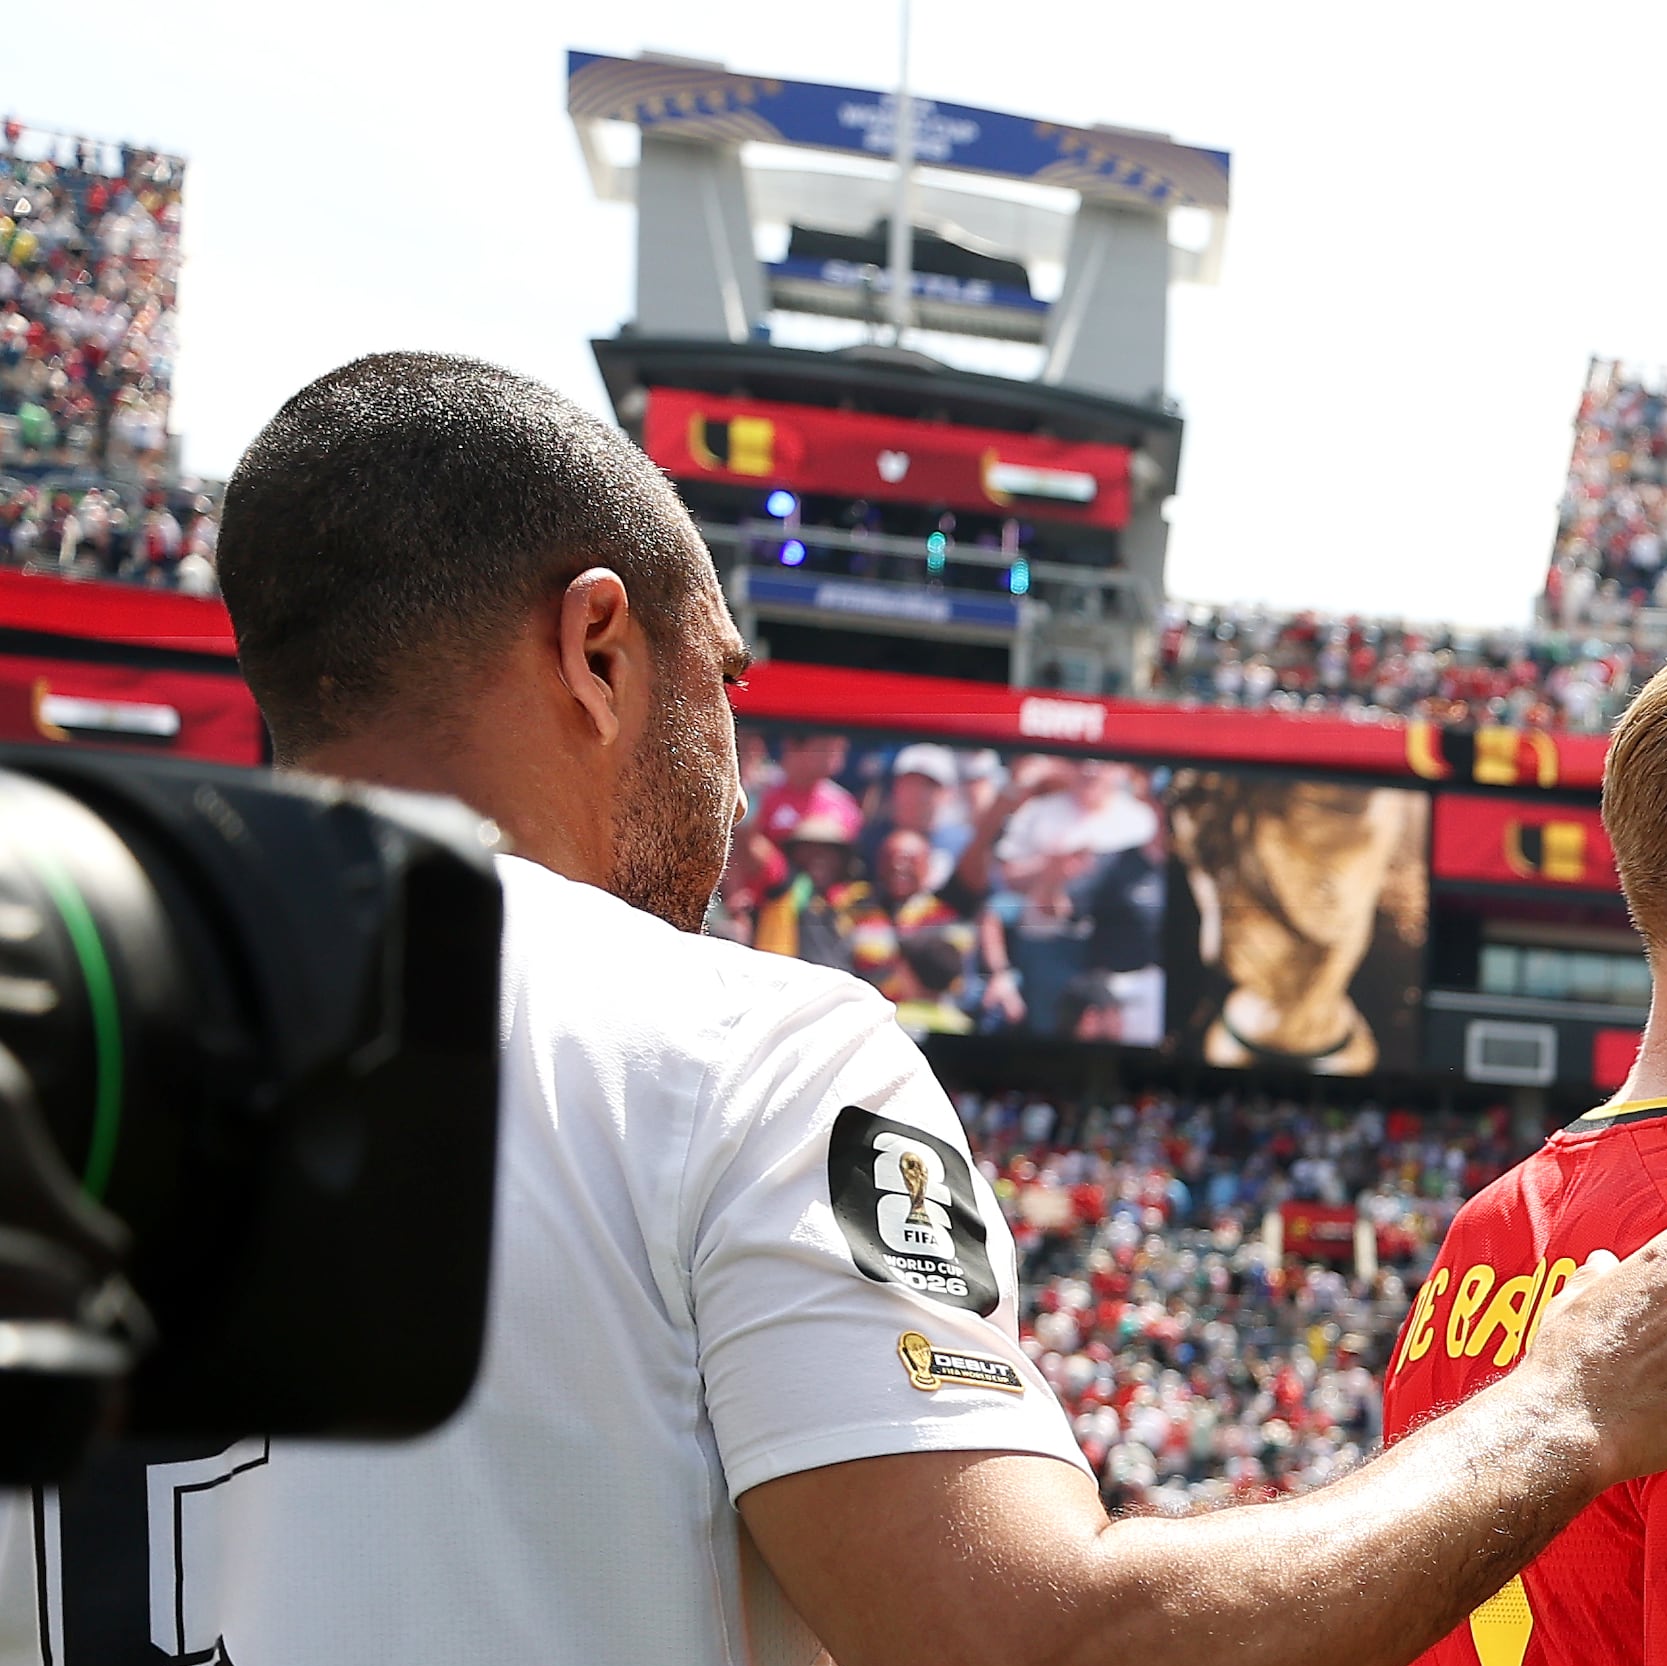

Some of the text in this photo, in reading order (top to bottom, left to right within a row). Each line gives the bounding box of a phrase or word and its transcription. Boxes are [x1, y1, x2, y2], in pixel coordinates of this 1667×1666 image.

[904, 1230, 939, 1246] FIFA
[882, 1254, 964, 1277] WORLD CUP
[934, 1353, 1010, 1377] DEBUT
